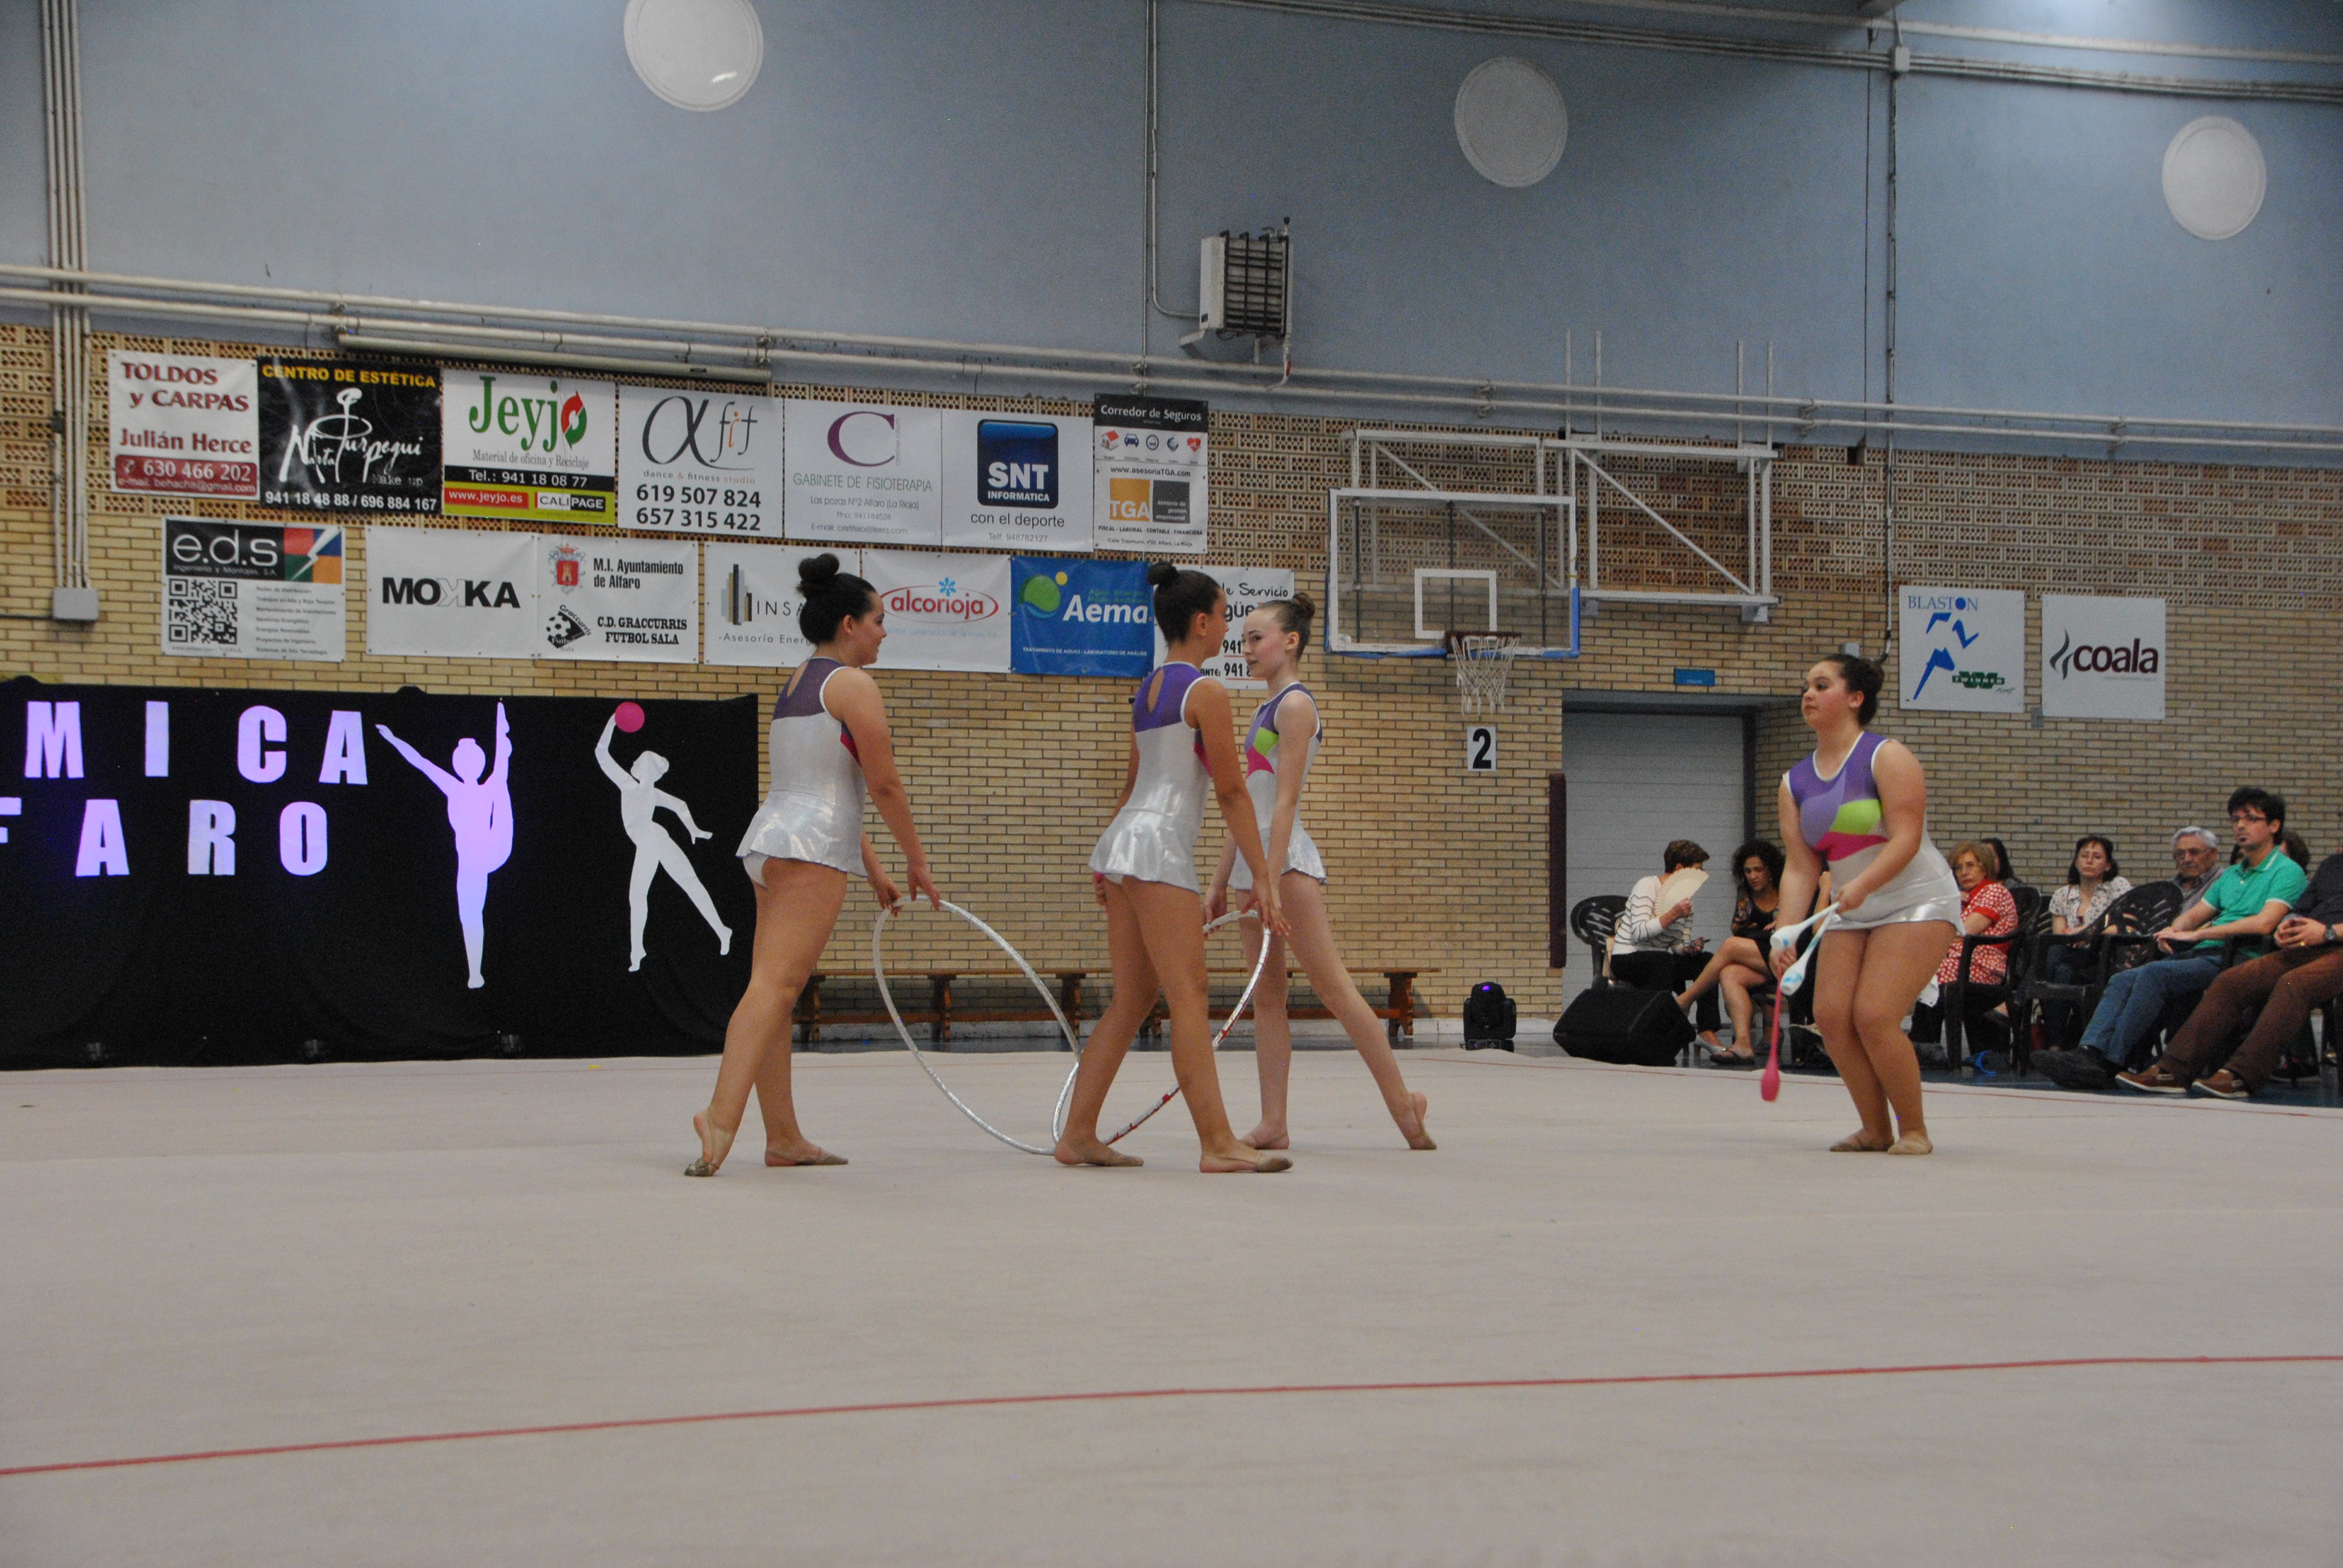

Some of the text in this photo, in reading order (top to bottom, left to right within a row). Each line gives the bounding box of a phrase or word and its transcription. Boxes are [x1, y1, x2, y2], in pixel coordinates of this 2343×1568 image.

[120, 362, 218, 385] TOLDOS
[261, 364, 329, 381] CENTRO
[335, 368, 355, 382] DE
[129, 390, 249, 412] y CARPAS
[469, 375, 587, 452] Jeyjo
[1101, 405, 1202, 422] Corredor de Seguros
[120, 428, 252, 453] Julián Herce
[827, 411, 895, 467] C
[472, 449, 589, 469] Material de oficina y Reciclaje
[143, 459, 251, 482] 630 466 202
[468, 469, 587, 488] Tel.: 941 18 08 77
[644, 470, 673, 479] dance
[688, 472, 719, 482] fitness
[988, 462, 1049, 490] SNT
[793, 473, 932, 492] GABINETE DE FISIOTERAPIA
[265, 491, 289, 504] 941
[295, 492, 310, 505] 18
[313, 493, 330, 506] 48
[334, 494, 350, 506] 88
[361, 495, 384, 508] 696
[387, 497, 410, 509] 884
[415, 498, 437, 511] 167
[449, 491, 604, 509] www.jeyjo.es CALIPAGE
[637, 485, 761, 508] 619 507 824
[811, 496, 822, 505] Las
[824, 498, 847, 506] pozas
[864, 498, 885, 508] Alfaro
[887, 499, 897, 509] (La
[899, 500, 919, 510] Rioja)
[988, 491, 1050, 502] INFORMATICA
[1110, 500, 1150, 518] TGA
[637, 508, 761, 531] 657 315 422
[971, 513, 1064, 529] con el deporte
[1006, 533, 1047, 542] 948782127
[594, 558, 683, 575] M.I. Ayuntamiento
[594, 575, 640, 589] de Alfaro
[1239, 583, 1288, 597] Servicio
[891, 589, 983, 620] alcorioja
[1063, 595, 1148, 624] Aema
[1908, 596, 1979, 610] BLASTON
[597, 616, 687, 630] C.D. GRACCURRIS
[606, 632, 680, 645] FUTBOL SALA
[2073, 637, 2158, 673] coala
[1224, 662, 1243, 677] 941
[1472, 728, 1492, 769] 2
